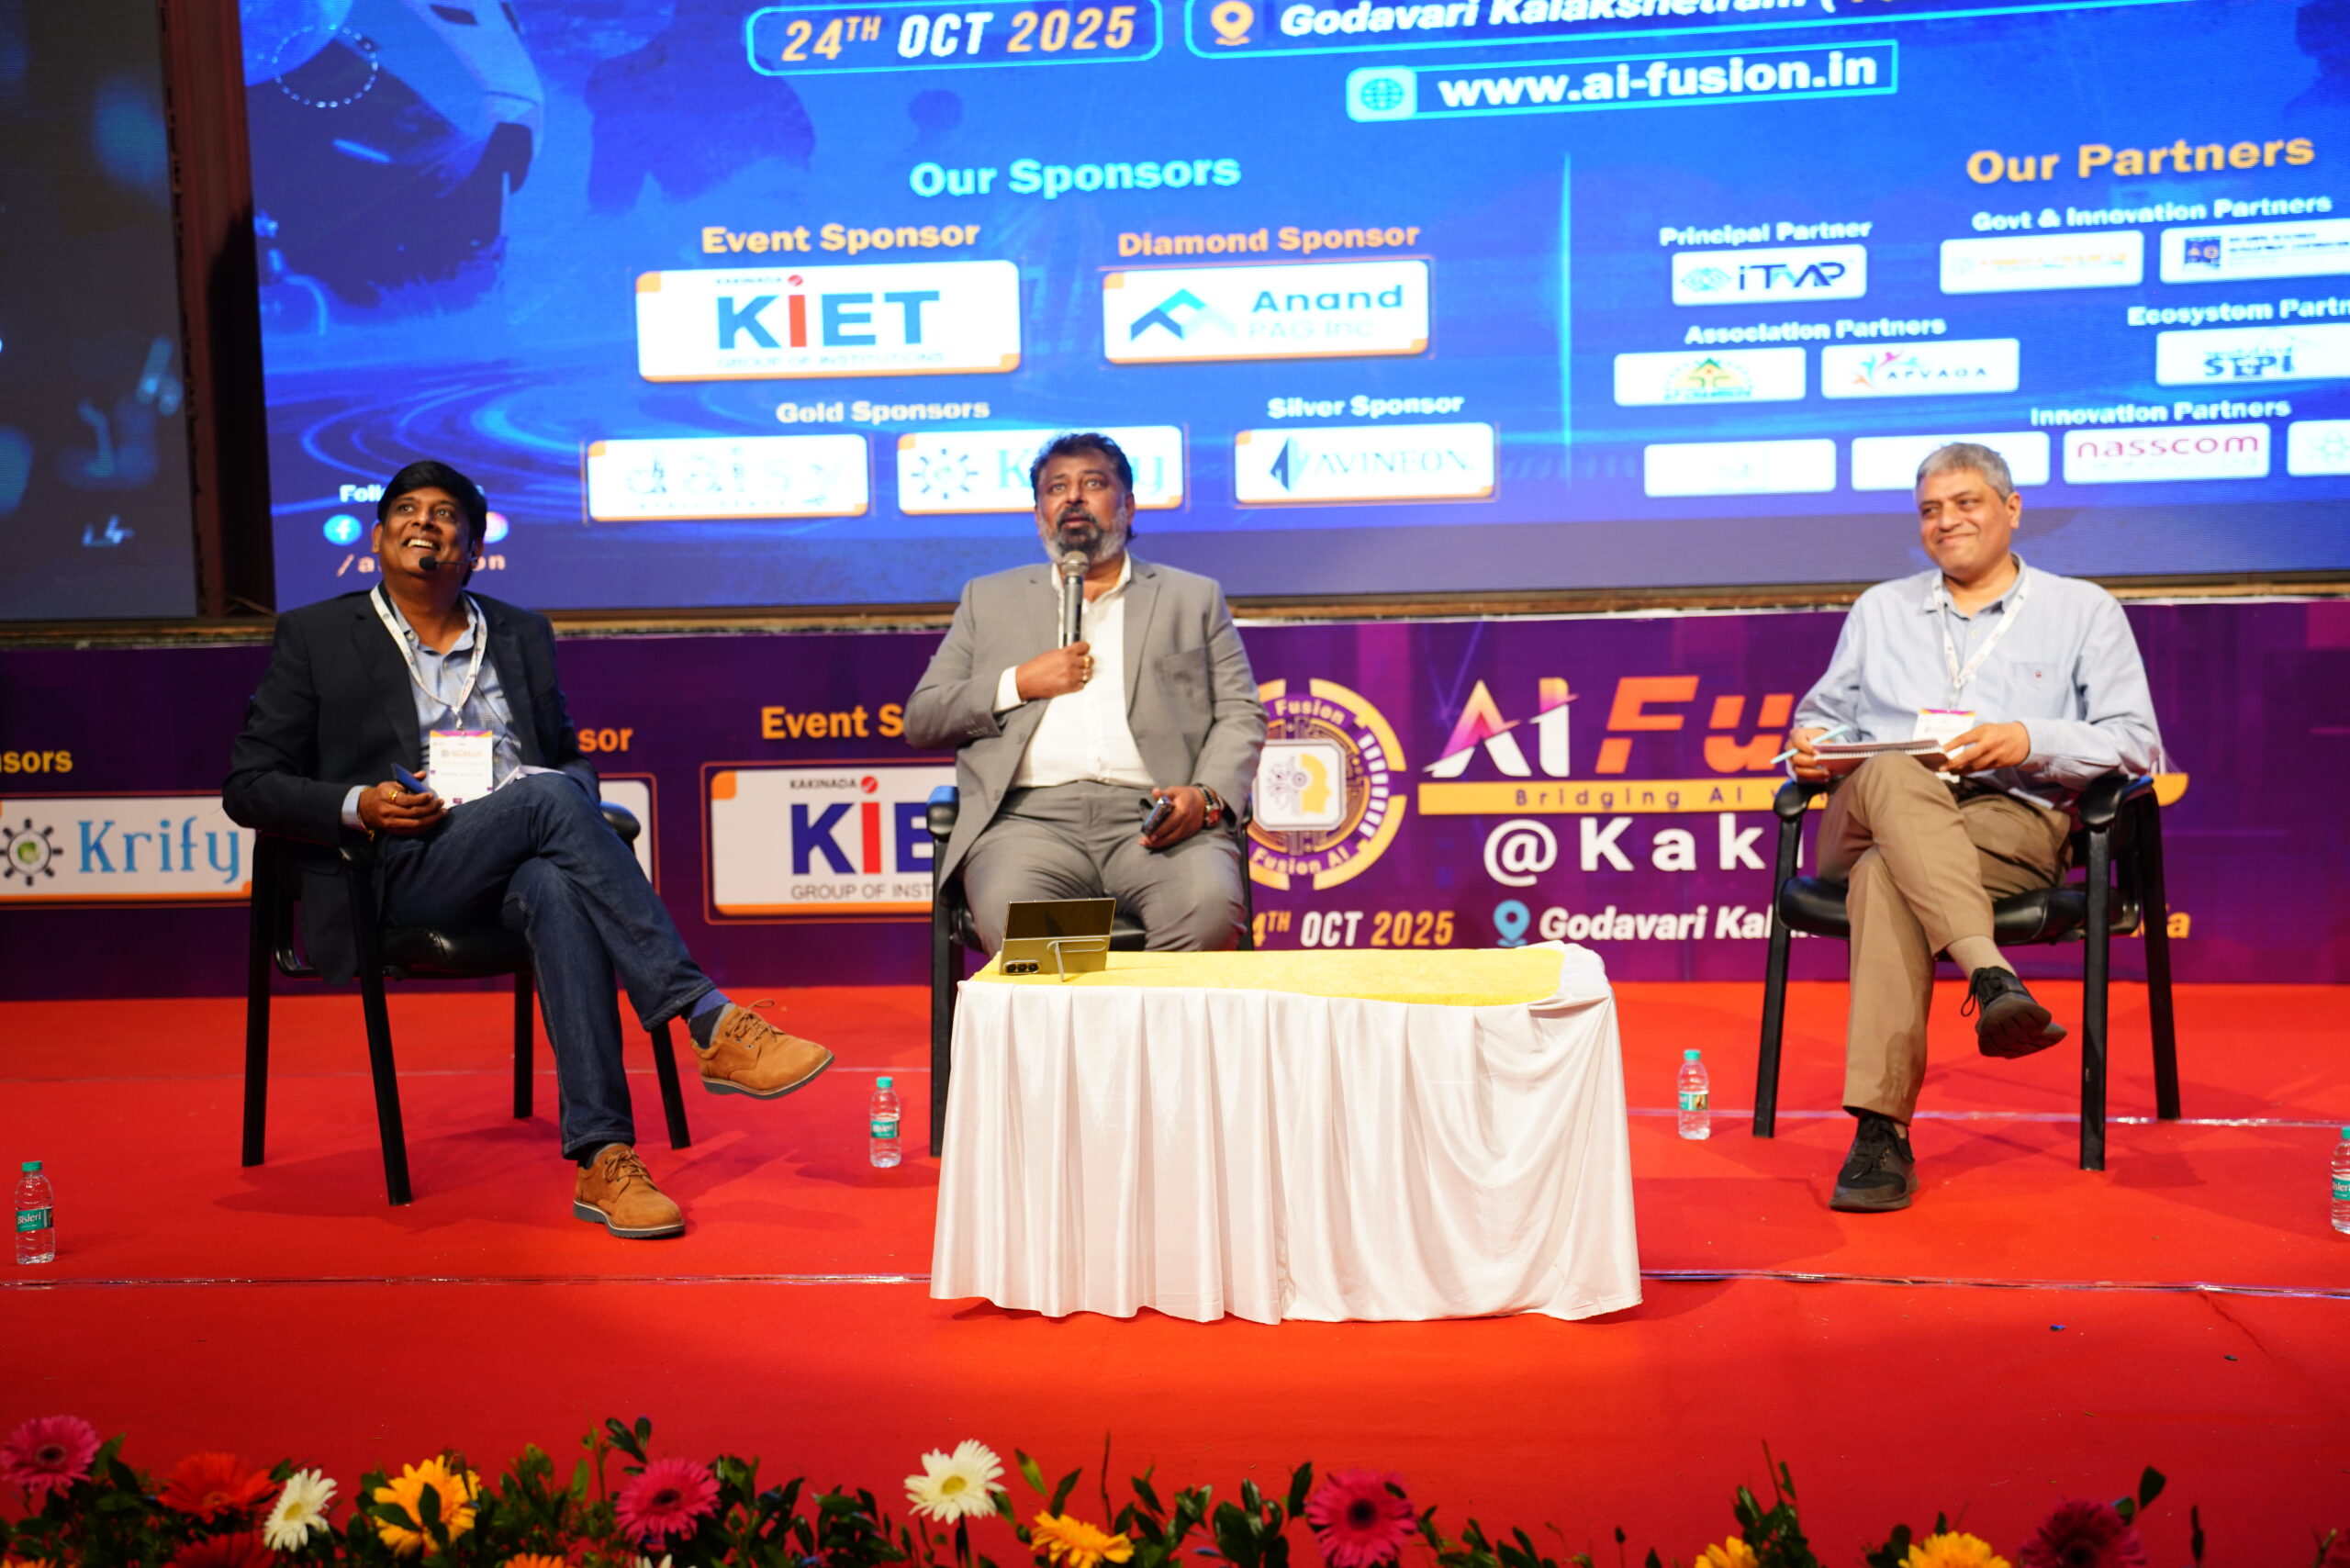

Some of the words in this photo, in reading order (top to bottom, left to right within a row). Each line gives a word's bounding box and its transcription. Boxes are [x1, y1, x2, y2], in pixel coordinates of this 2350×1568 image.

[1281, 0, 1480, 36] Godavari
[782, 16, 882, 62] 24TH
[898, 12, 994, 59] OCT
[1007, 6, 1137, 52] 2025
[1438, 50, 1876, 107] www.ai-fusion.in
[1966, 150, 2060, 184] Our
[2078, 138, 2315, 178] Partners
[909, 162, 997, 196] Our
[1008, 158, 1241, 199] Sponsors
[1972, 210, 2032, 232] Govt
[2038, 208, 2061, 229] &
[2066, 202, 2207, 228] Innovation
[2214, 196, 2333, 219] Partners
[702, 226, 811, 254] Event
[820, 223, 980, 255] Sponsor
[1118, 229, 1269, 257] Diamond
[1278, 227, 1420, 254] Sponsor
[1659, 223, 1770, 247] Principal
[1775, 219, 1873, 242] Partner
[1251, 285, 1404, 313] Anand
[2127, 302, 2274, 327] Ecosystem
[2280, 297, 2350, 319] Partn
[1684, 319, 1830, 345] Association
[1835, 318, 1947, 340] Partners
[776, 402, 844, 423] Gold
[851, 400, 990, 424] Sponsors
[1267, 397, 1345, 419] Silver
[1349, 394, 1465, 419] Sponsor
[2031, 403, 2167, 426] Innovation
[2174, 399, 2291, 421] Partners
[2077, 435, 2258, 458] nasscom
[1315, 449, 1469, 475] AVINEON
[340, 485, 385, 502] Foll
[761, 705, 869, 739] Event
[1274, 698, 1346, 725] Fusion
[1595, 676, 1795, 773] Fu
[578, 728, 633, 752] sor
[0, 750, 73, 773] sors
[789, 778, 857, 790] KAKINADA
[1516, 787, 1681, 811] Bridging
[1709, 786, 1742, 803] AI
[78, 815, 240, 884] Krify
[1251, 846, 1322, 876] Fusion
[790, 884, 857, 901] GROUP
[862, 883, 886, 900] OF
[892, 883, 934, 899] INST
[1300, 911, 1364, 947] OCT
[1371, 911, 1455, 946] 2025
[1539, 904, 1708, 940] Godavari
